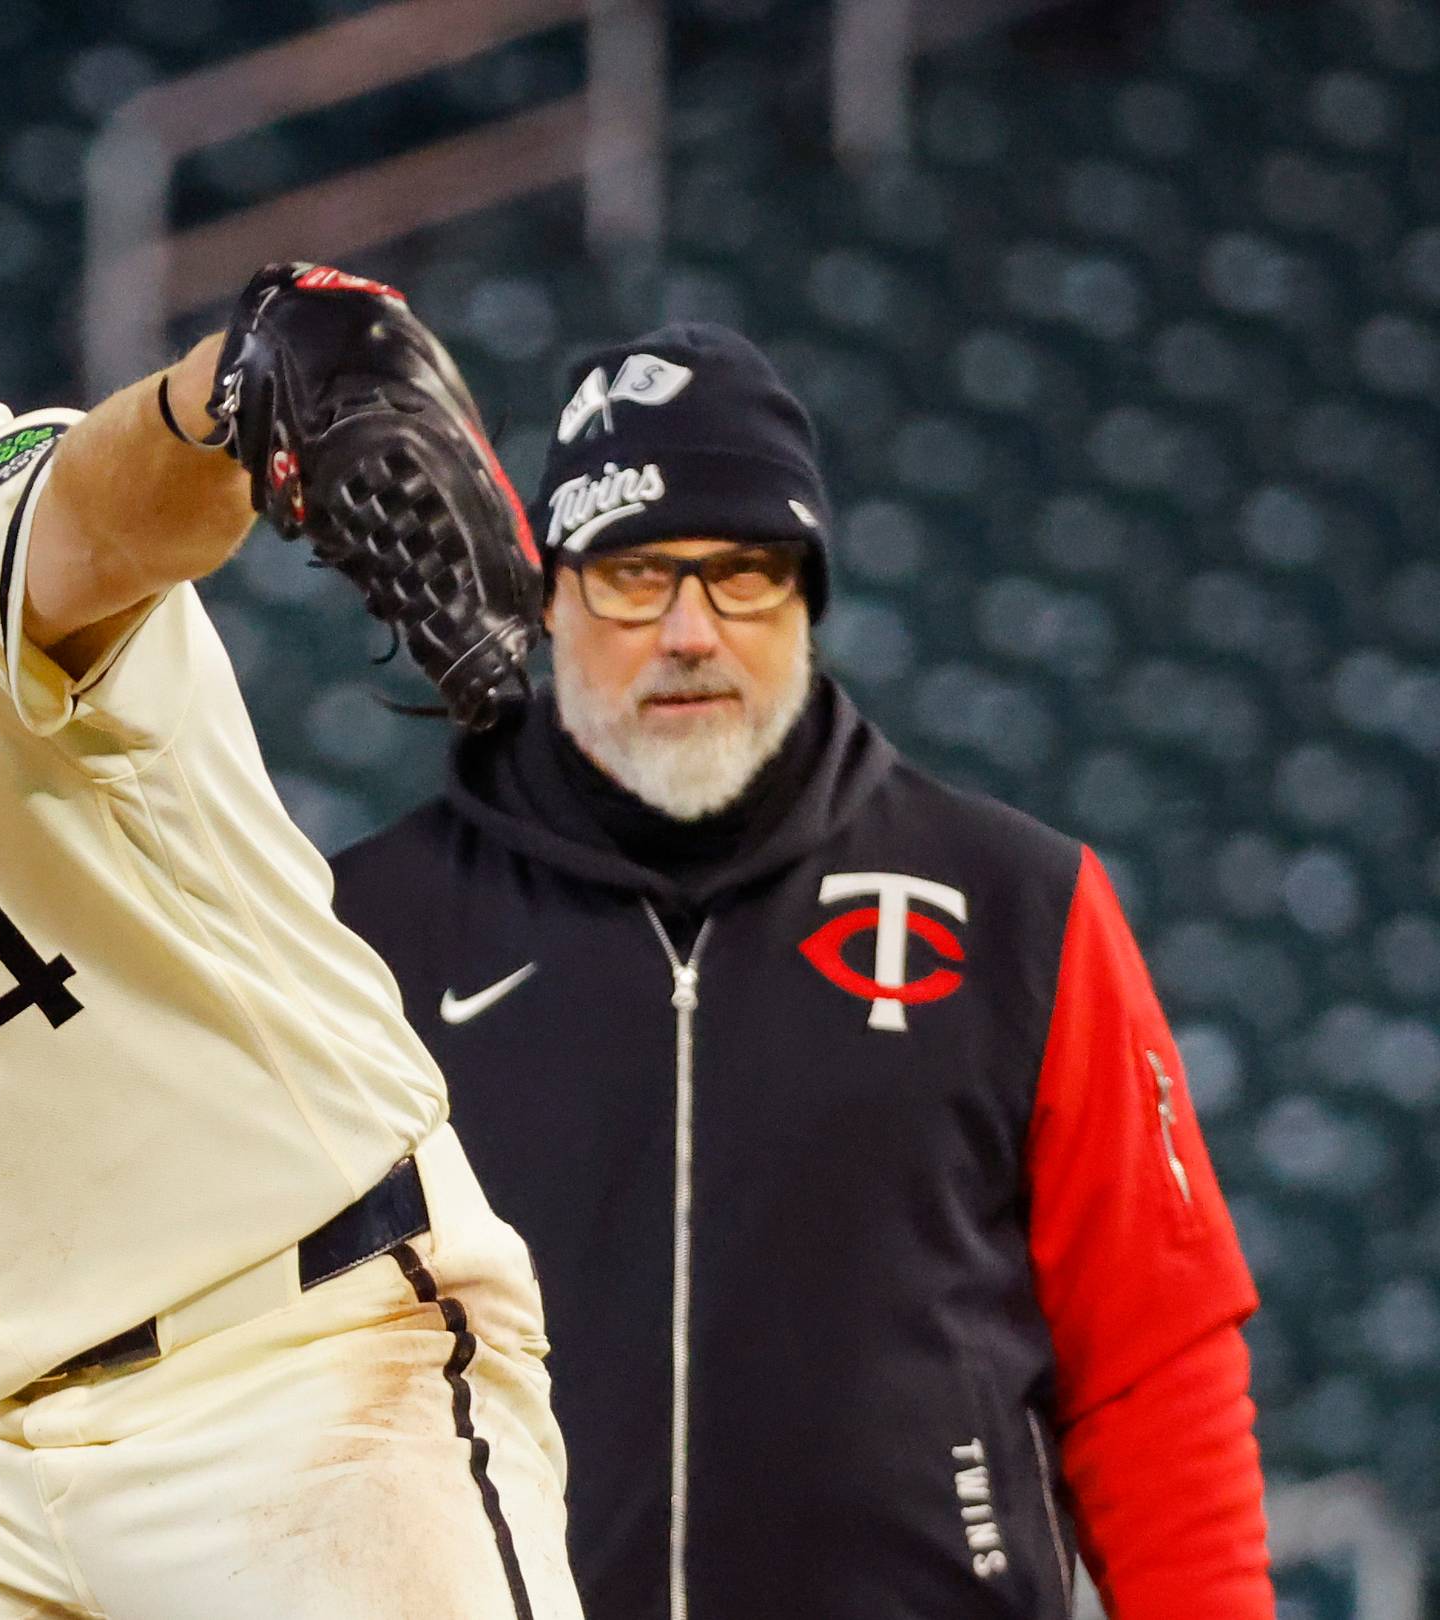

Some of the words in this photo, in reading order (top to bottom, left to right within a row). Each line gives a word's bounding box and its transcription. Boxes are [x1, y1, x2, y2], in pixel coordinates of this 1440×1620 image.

[631, 363, 665, 392] S
[546, 461, 666, 550] Twins
[951, 1437, 1008, 1580] TWINS
